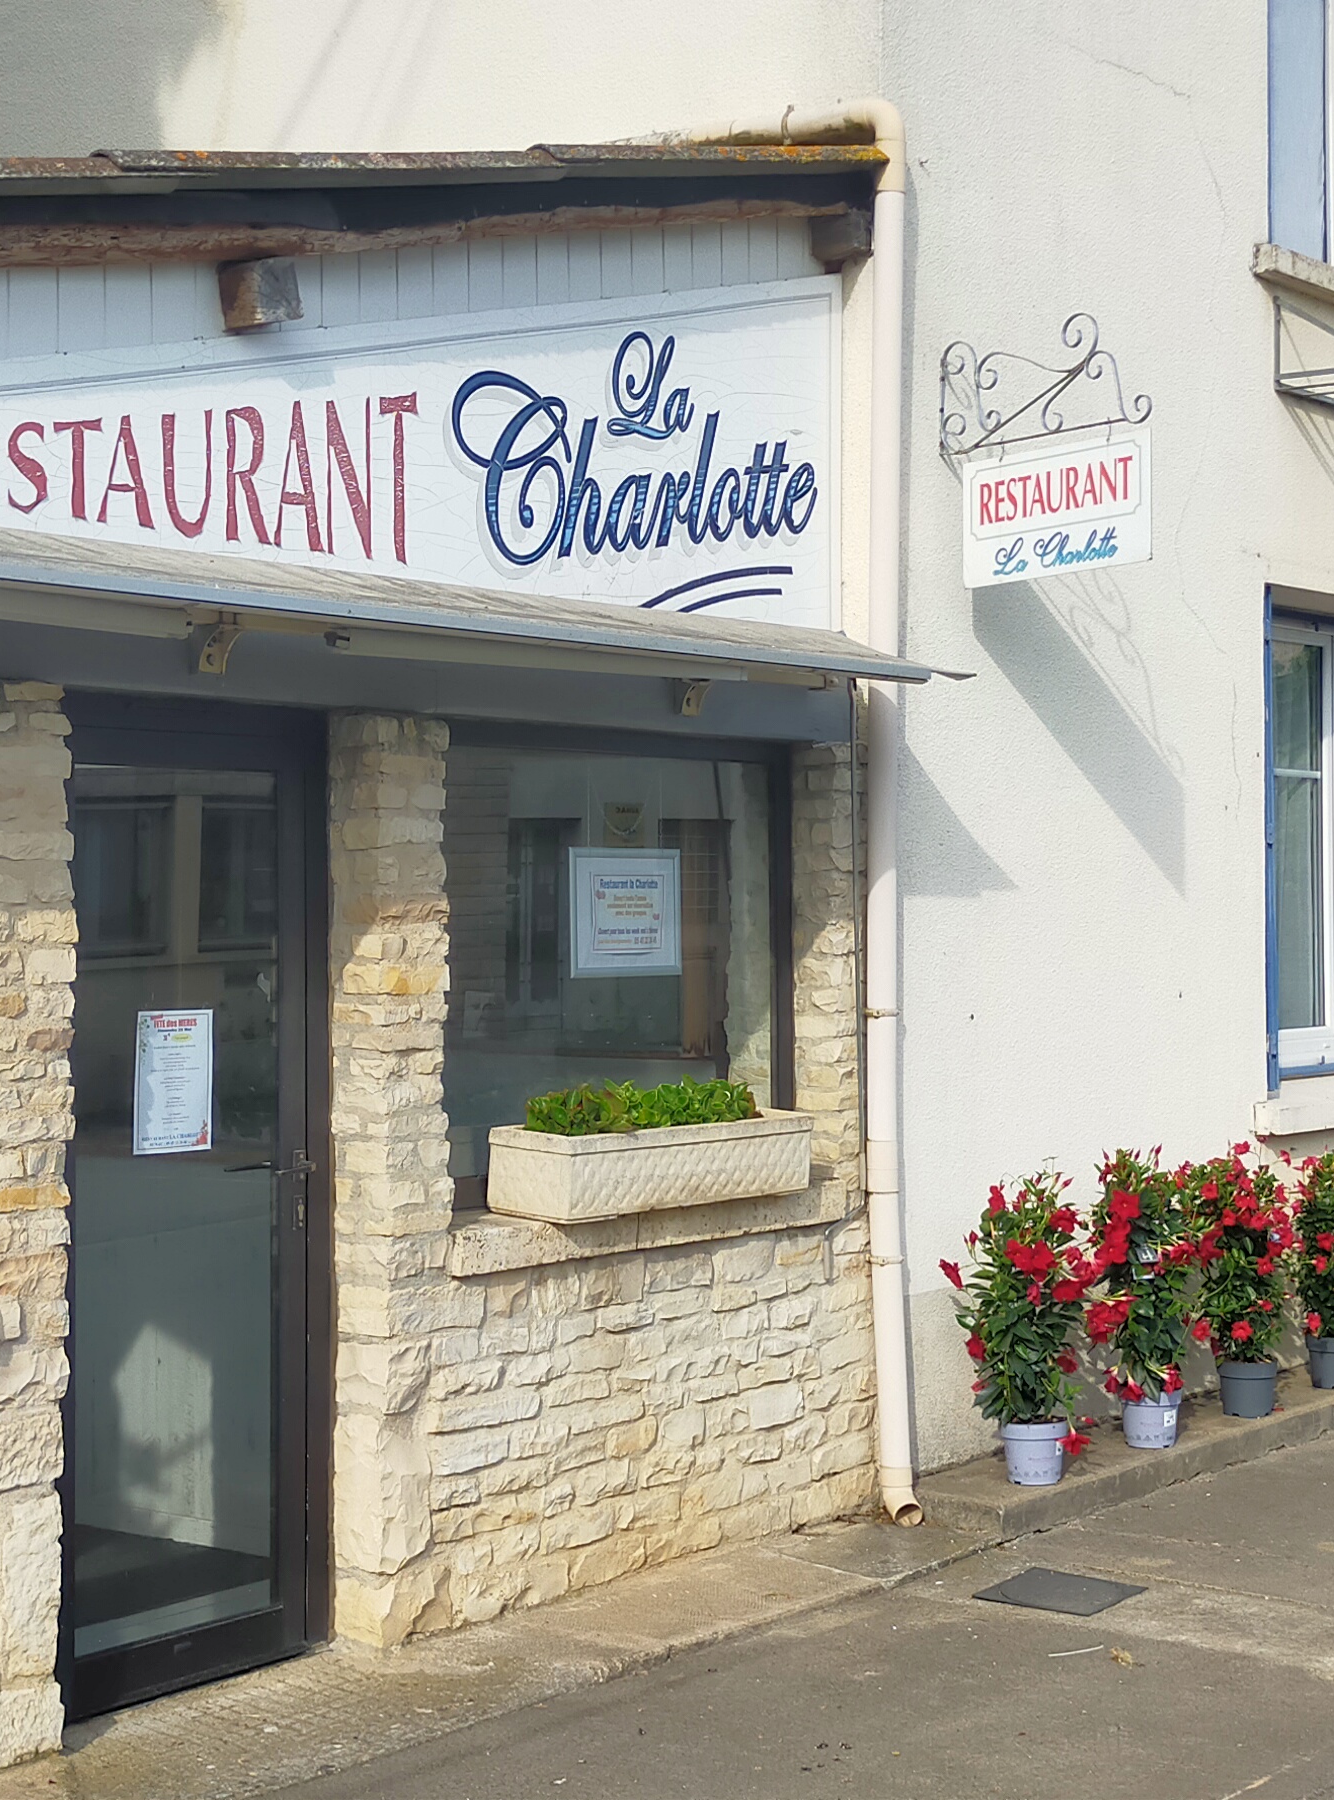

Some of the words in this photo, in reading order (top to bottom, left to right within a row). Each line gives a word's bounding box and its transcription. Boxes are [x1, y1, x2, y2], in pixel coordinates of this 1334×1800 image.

[607, 331, 694, 441] La
[451, 370, 817, 565] Charlotte
[980, 455, 1133, 526] RESTAURANT
[993, 537, 1029, 576] La
[1033, 526, 1119, 568] Charlotte
